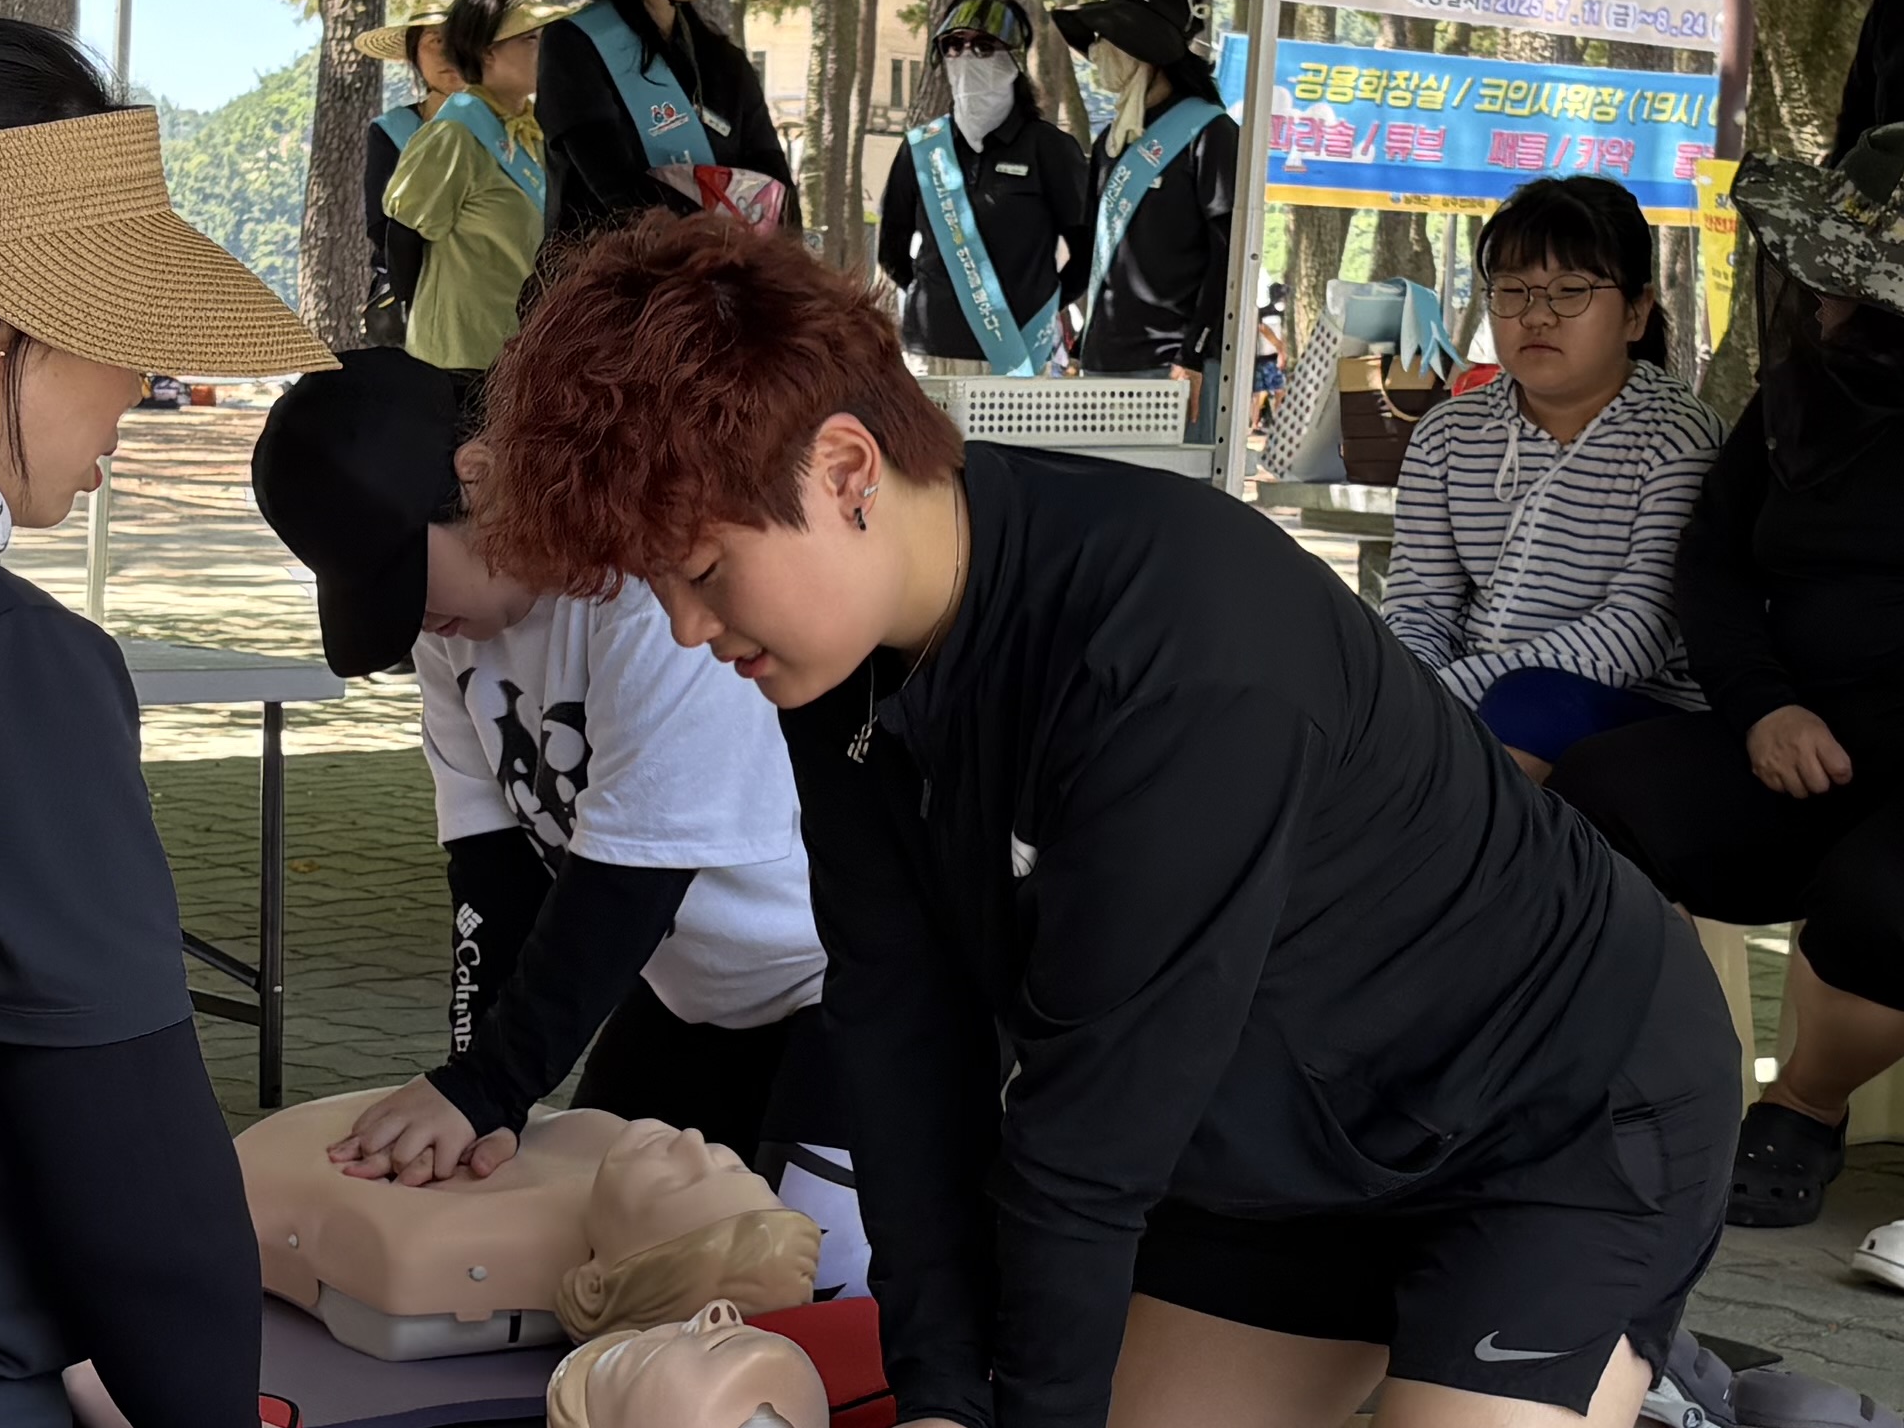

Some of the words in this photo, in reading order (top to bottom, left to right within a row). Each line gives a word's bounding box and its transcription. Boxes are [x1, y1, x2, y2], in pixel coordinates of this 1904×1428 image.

[1295, 61, 1451, 110] 공용화장실
[1474, 77, 1627, 122] 코인샤워장
[1385, 122, 1446, 162] 튜브
[1574, 134, 1636, 177] 카약
